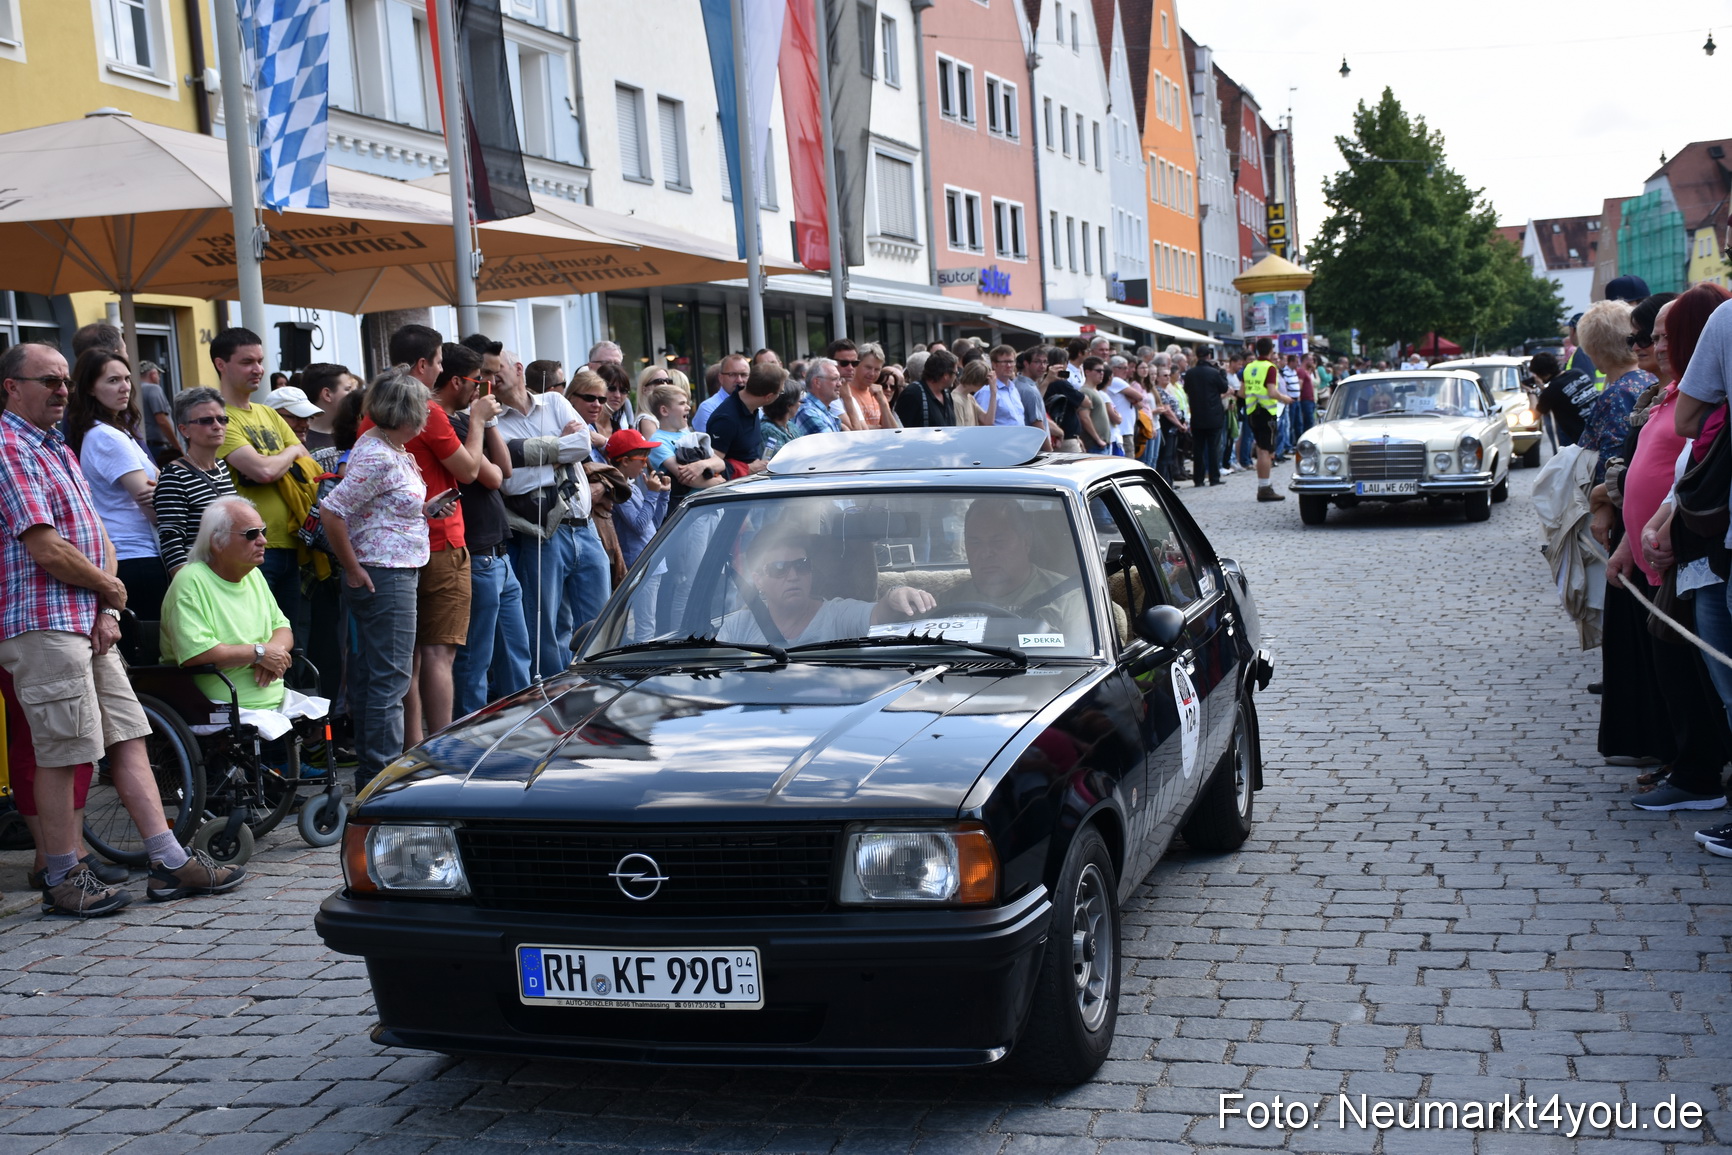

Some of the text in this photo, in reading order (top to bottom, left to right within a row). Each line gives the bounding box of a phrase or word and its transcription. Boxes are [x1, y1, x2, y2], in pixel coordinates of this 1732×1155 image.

[1268, 203, 1286, 258] HOT
[1362, 483, 1380, 493] LAU
[1398, 482, 1416, 493] 69H
[923, 621, 965, 631] 203
[1034, 636, 1062, 644] DEKRA
[736, 956, 752, 968] 04
[543, 953, 733, 995] RH KF 990
[529, 977, 538, 988] D
[739, 983, 754, 995] 10
[565, 999, 614, 1007] AUTO-DENZLER
